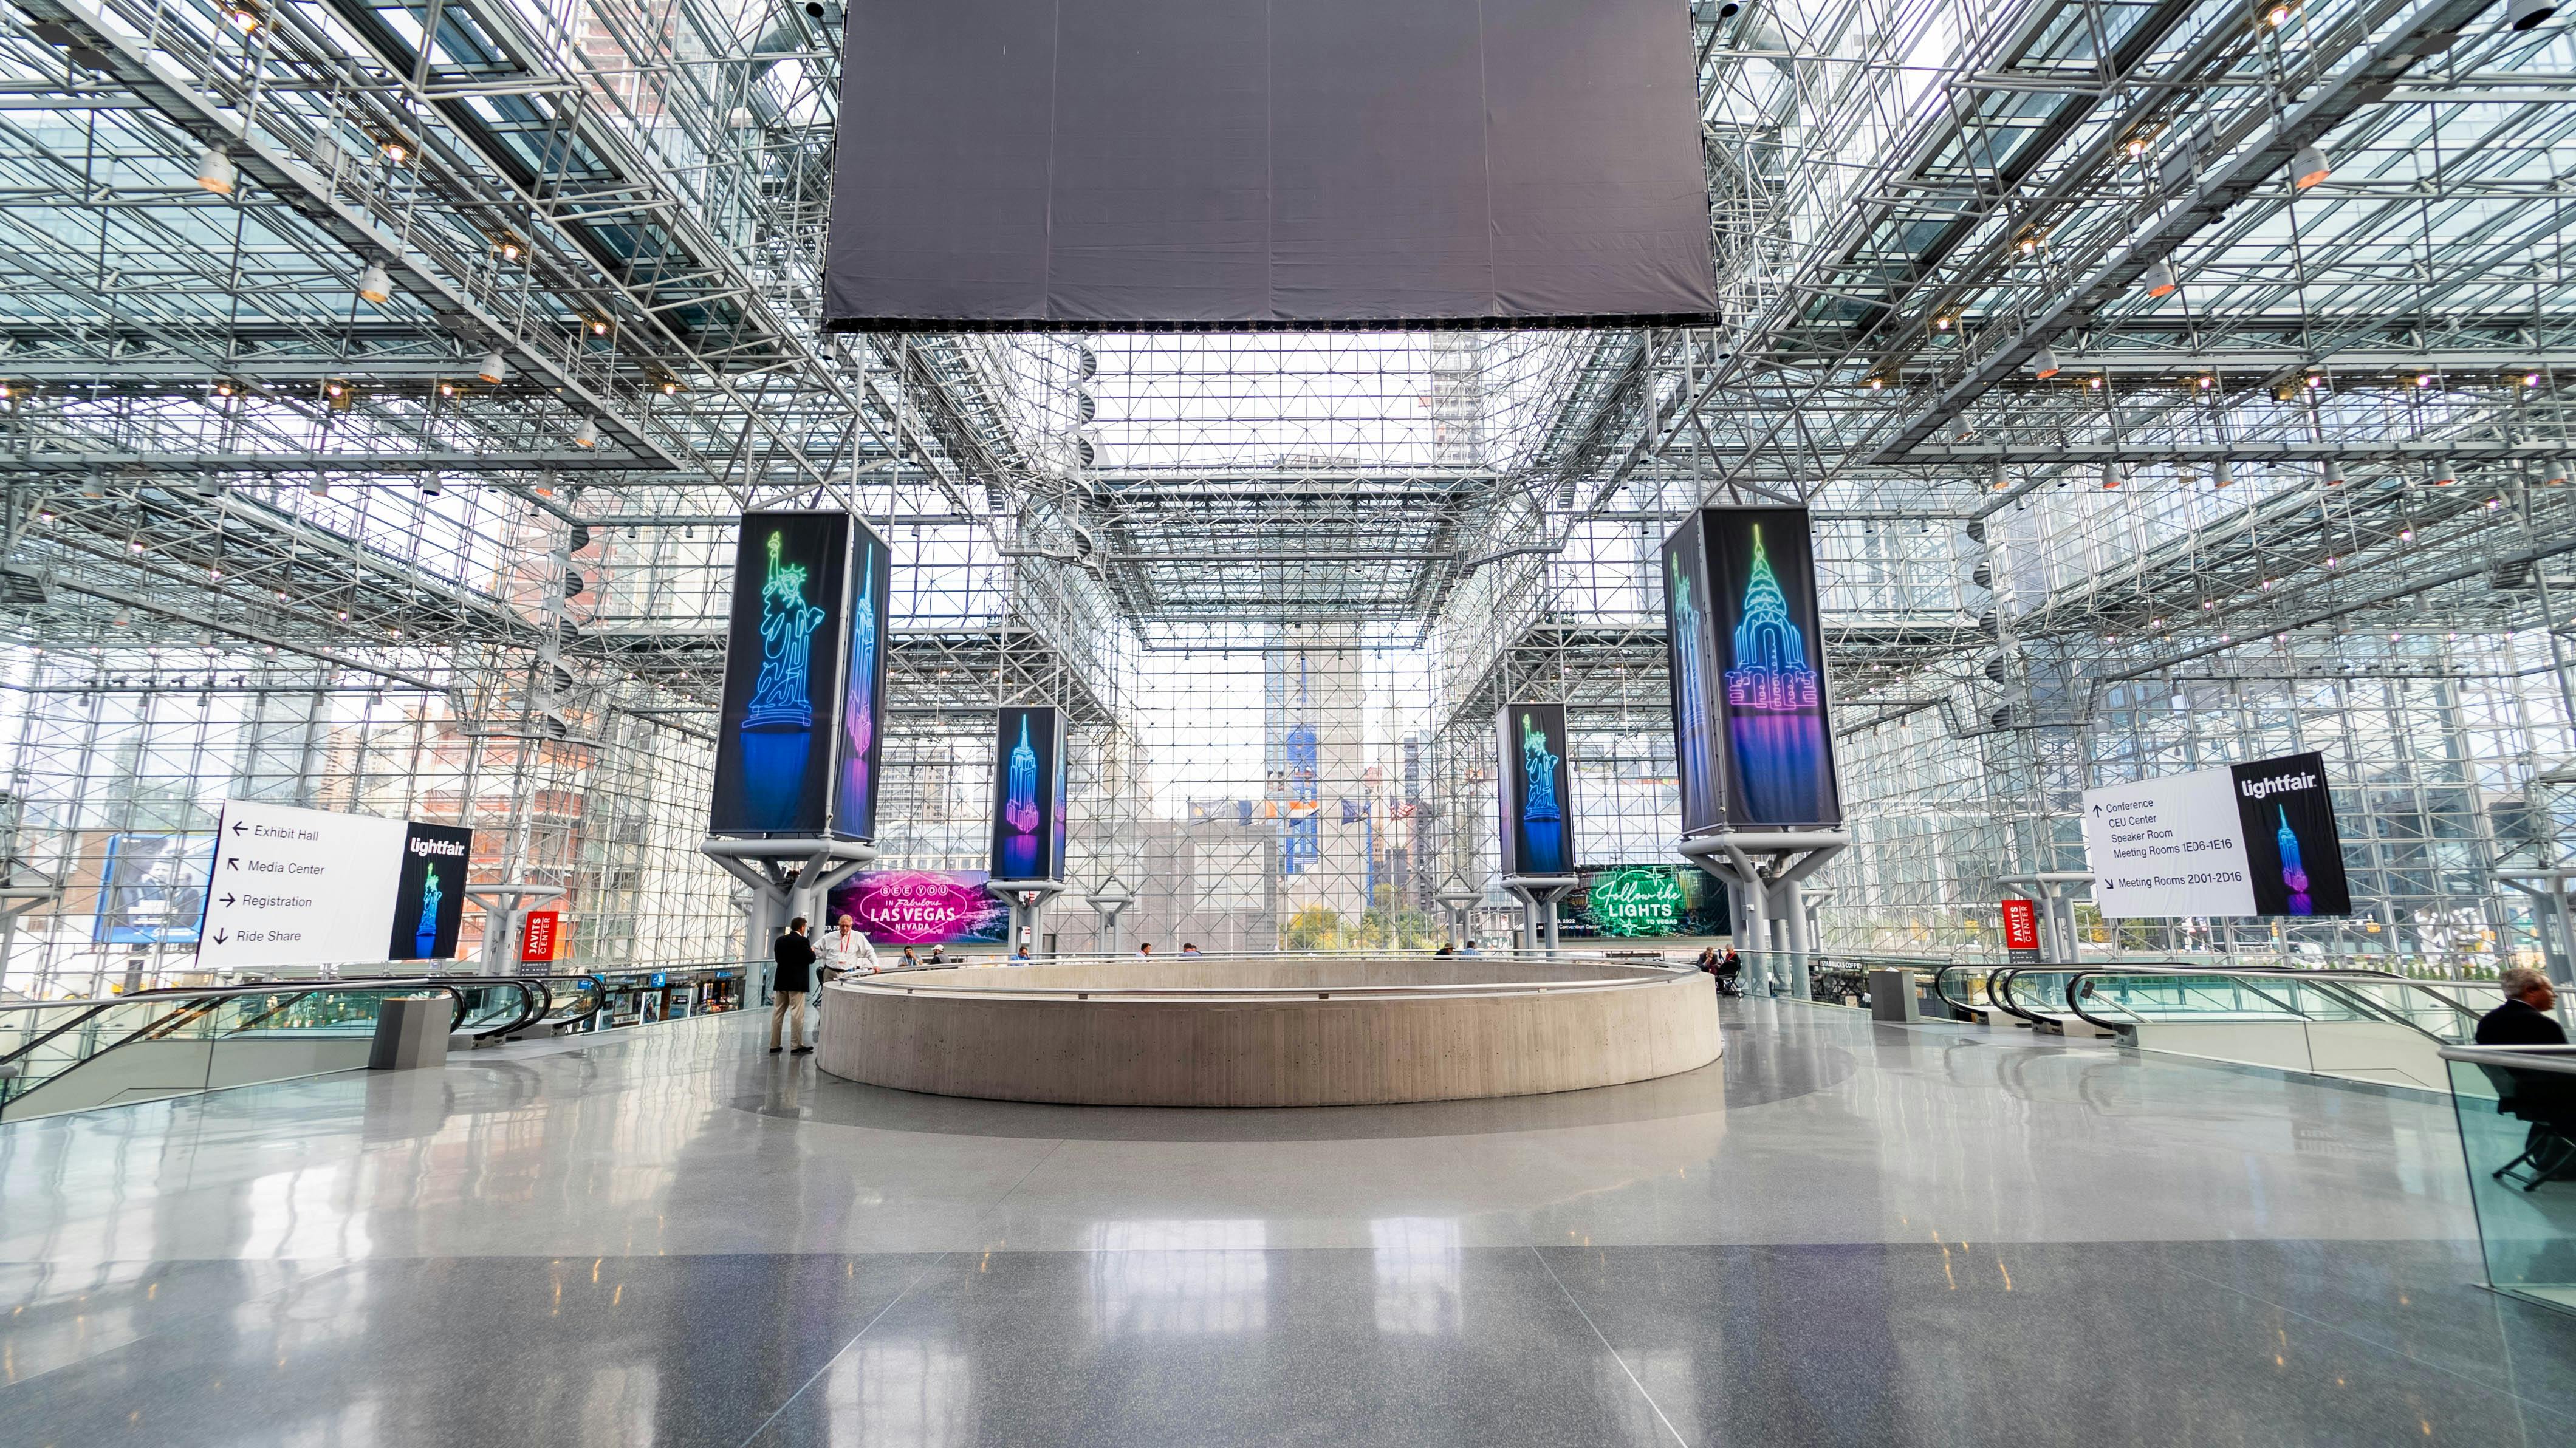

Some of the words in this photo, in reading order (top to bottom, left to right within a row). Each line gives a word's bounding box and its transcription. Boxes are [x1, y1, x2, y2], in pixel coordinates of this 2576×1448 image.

[2241, 771, 2316, 799] lightfair
[2106, 799, 2154, 813] Conference
[2109, 817, 2126, 828] CEU
[2128, 814, 2157, 825] Center
[255, 825, 294, 839] Exhibit
[298, 829, 319, 841] Hall
[2111, 832, 2145, 844] Speaker
[2146, 830, 2173, 840] Room
[410, 837, 465, 856] lightfair
[2114, 847, 2147, 858] Meeting
[2149, 845, 2180, 855] Rooms
[2182, 838, 2232, 851] 1E06-1E16
[248, 860, 284, 873] Media
[288, 862, 325, 875] Center
[2119, 878, 2151, 889] Meeting
[2154, 876, 2185, 886] Rooms
[2187, 872, 2242, 884] 2D01-2D16
[882, 886, 911, 895] SEE
[917, 886, 947, 895] YOU
[1596, 881, 1655, 908] Follow
[1656, 884, 1682, 900] the
[242, 895, 312, 909] Registration
[894, 899, 942, 908] Fabulous
[871, 908, 900, 921] LAS
[903, 907, 956, 921] VEGAS
[1609, 904, 1673, 917] LIGHTS
[2010, 906, 2023, 942] JAVITS
[2021, 906, 2032, 942] CENTER
[237, 931, 264, 941] Ride
[268, 931, 301, 941] Share
[529, 918, 541, 954] JAVITS
[540, 918, 550, 954] CENTER
